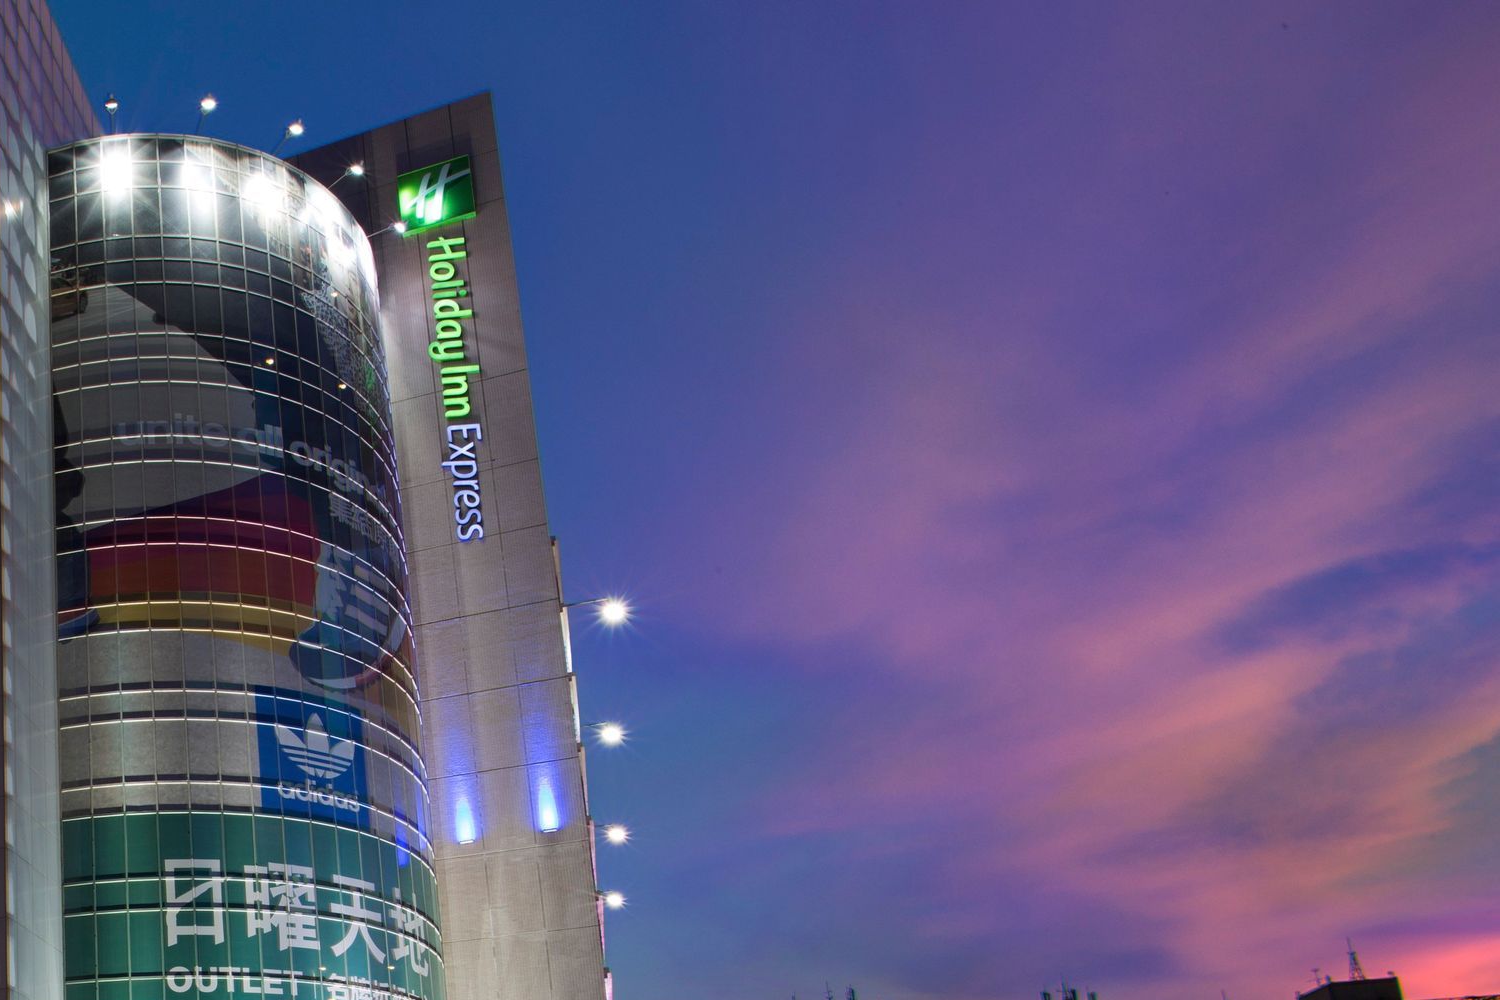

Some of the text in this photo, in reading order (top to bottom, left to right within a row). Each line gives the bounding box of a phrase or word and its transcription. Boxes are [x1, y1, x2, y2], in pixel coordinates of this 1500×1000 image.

[426, 236, 486, 543] Holiday Inn Express
[115, 412, 227, 447] unite
[242, 423, 285, 458] all
[277, 778, 360, 813] adidas
[164, 859, 430, 978] 日曜天地
[166, 966, 303, 997] OUTLET
